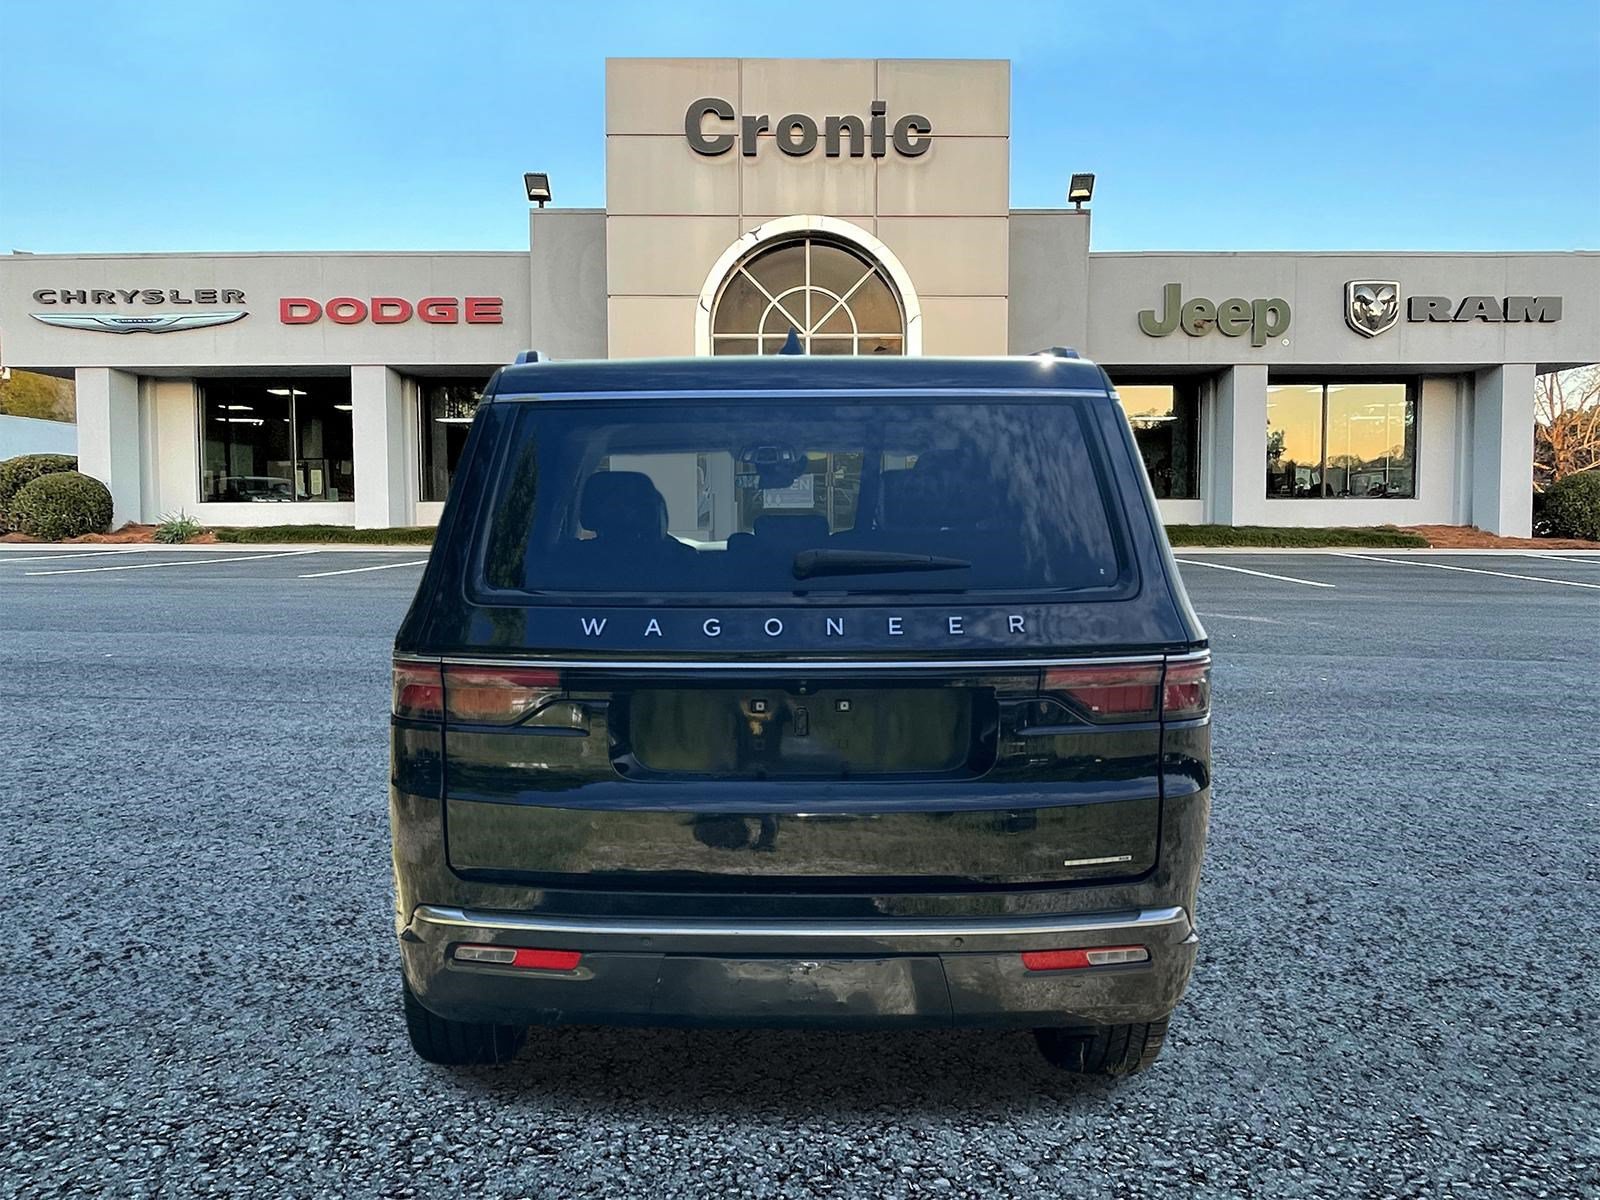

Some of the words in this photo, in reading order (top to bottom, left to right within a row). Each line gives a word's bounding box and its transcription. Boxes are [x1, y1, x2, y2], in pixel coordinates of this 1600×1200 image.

[685, 97, 932, 157] Cronic
[32, 289, 247, 305] CHRYSLER
[1407, 296, 1563, 322] RAM
[280, 297, 503, 324] DODGE
[1138, 283, 1291, 347] Jeep
[581, 615, 1025, 637] WAGONEER
